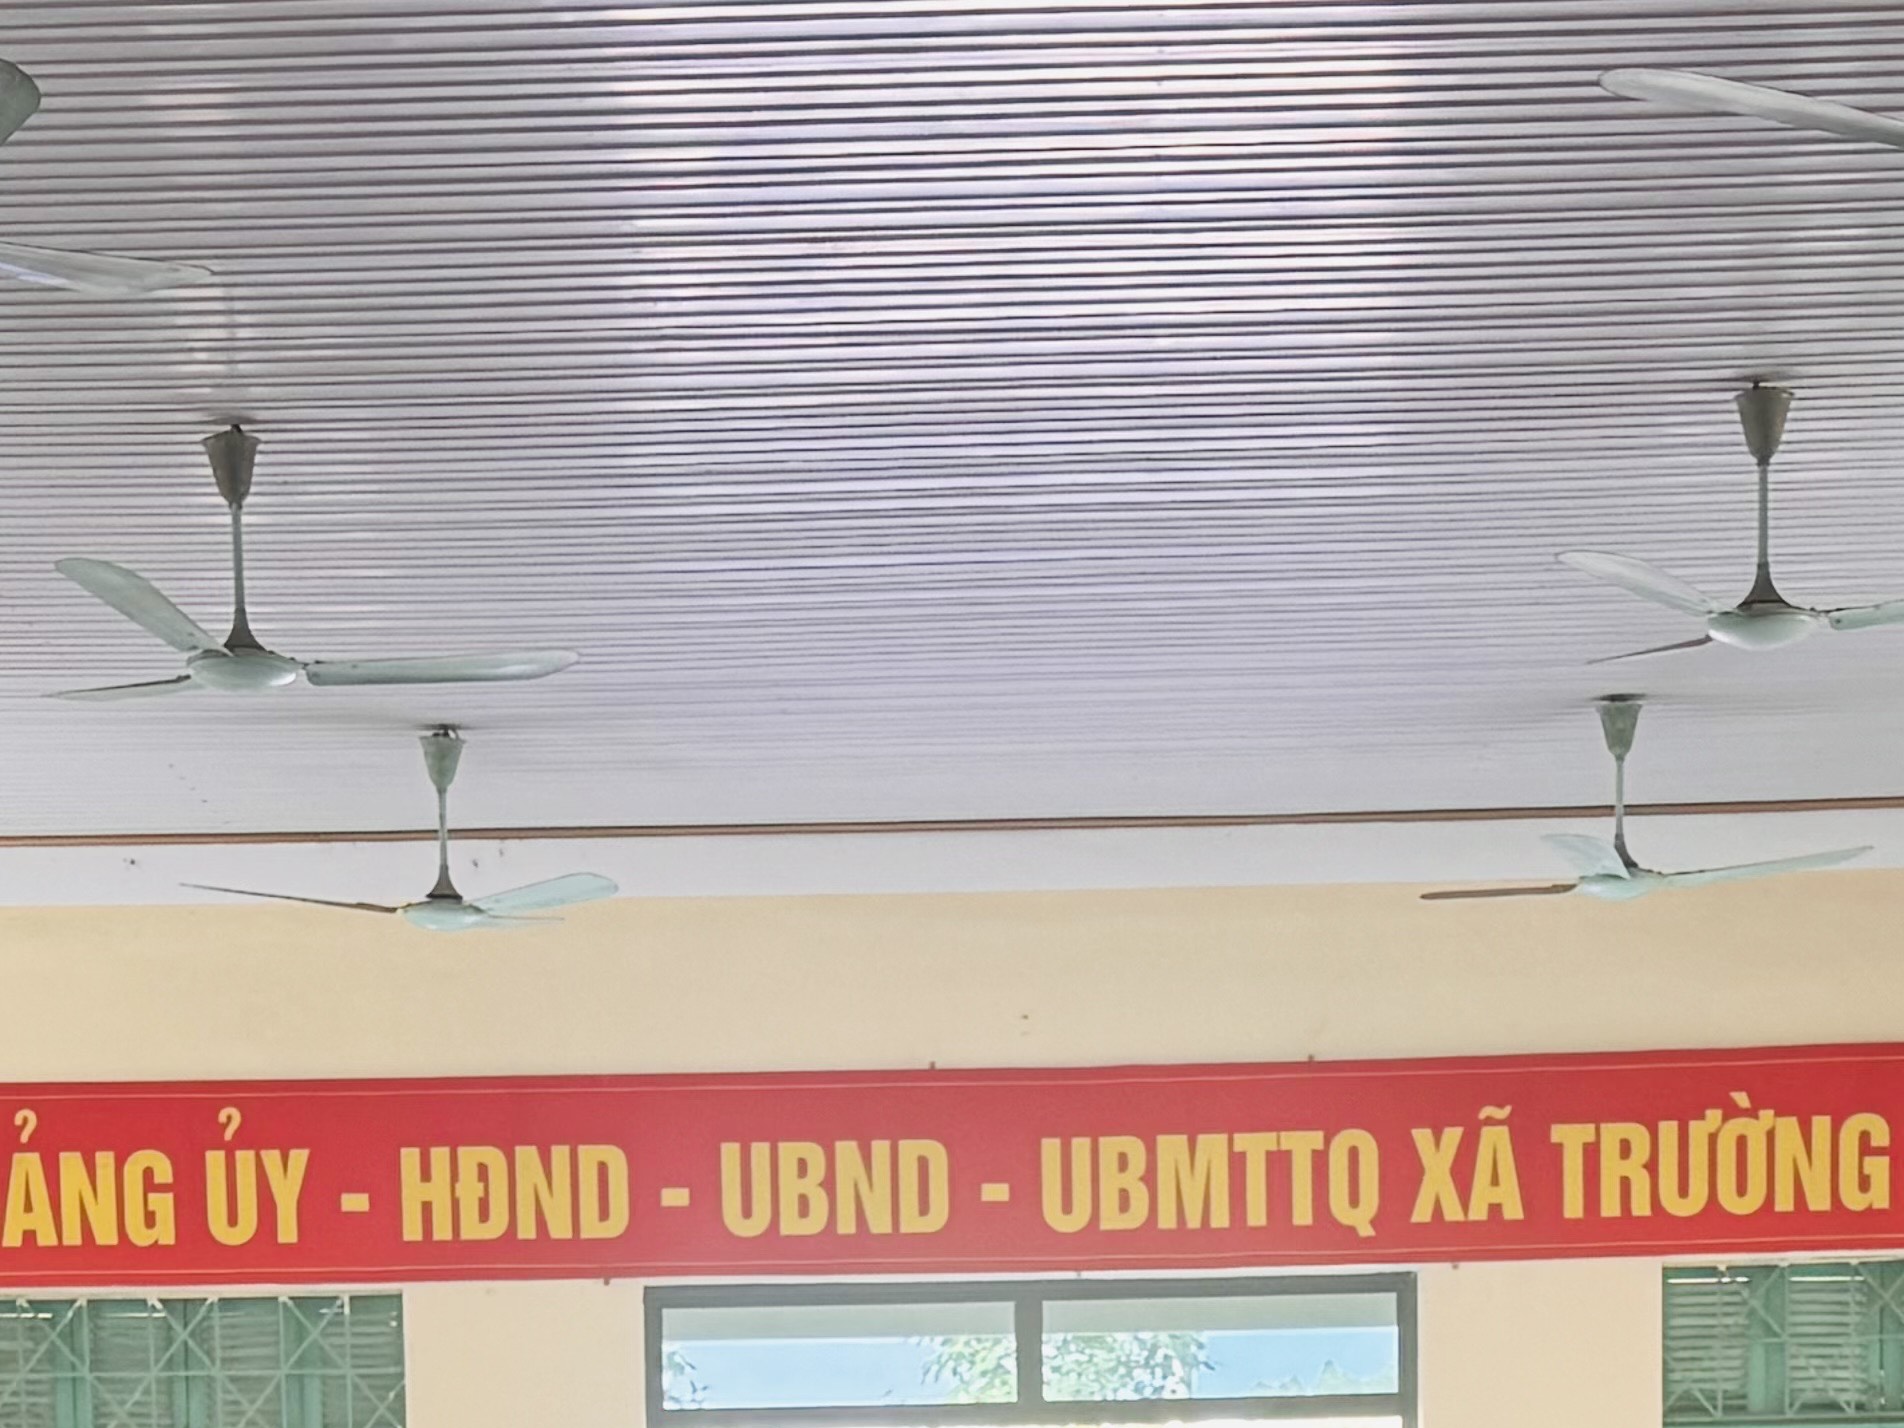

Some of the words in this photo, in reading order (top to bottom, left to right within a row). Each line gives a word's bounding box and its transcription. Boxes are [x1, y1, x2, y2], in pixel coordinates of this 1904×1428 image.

[341, 1193, 369, 1211] -
[401, 1145, 629, 1241] HĐND
[661, 1188, 689, 1206] -
[721, 1140, 949, 1237] UBND
[981, 1183, 1009, 1201] -
[1041, 1129, 1379, 1236] UBMTTQ
[1411, 1106, 1524, 1223] XÃ
[1551, 1092, 1889, 1218] TRƯỜNG
